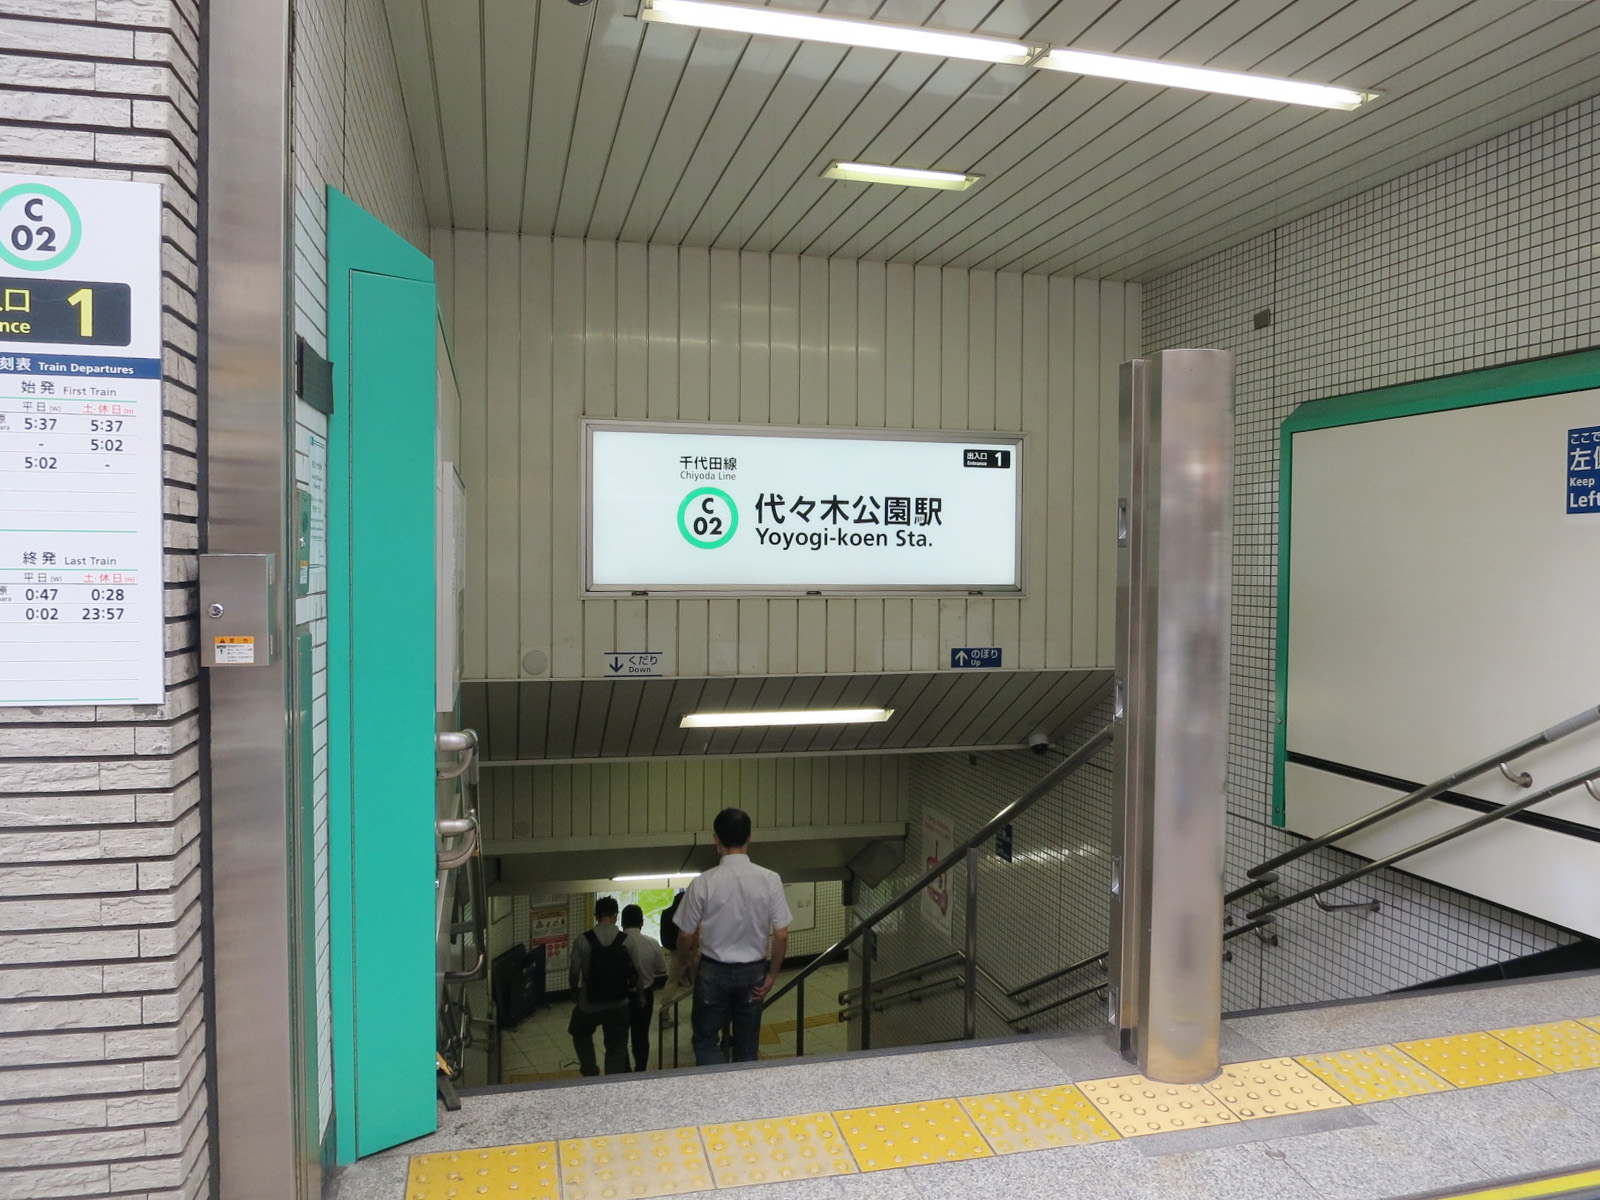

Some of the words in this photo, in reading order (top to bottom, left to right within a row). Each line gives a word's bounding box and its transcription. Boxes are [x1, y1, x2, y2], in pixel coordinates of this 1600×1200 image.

[24, 198, 44, 222] C
[11, 225, 57, 252] 02
[67, 288, 95, 338] 1
[38, 361, 67, 372] Train
[71, 363, 135, 375] Departures
[63, 386, 87, 396] First
[90, 387, 117, 397] Train
[24, 417, 57, 431] 5:37
[90, 419, 123, 433] 5:37
[90, 438, 124, 452] 5:02
[966, 451, 988, 460] 出入口
[994, 451, 1002, 467] 1
[24, 456, 58, 470] 5:02
[679, 455, 738, 471] 千代田線
[680, 471, 715, 482] Chiyoda
[718, 471, 737, 481] Line
[1569, 477, 1595, 488] Keep
[701, 497, 714, 515] C
[1569, 490, 1600, 508] Left
[755, 493, 943, 527] 代々木公園駅
[693, 516, 722, 537] 02
[755, 527, 888, 551] Yoyogi-koen
[895, 529, 933, 548] Sta.
[64, 556, 87, 566] Last
[90, 556, 117, 566] Train
[25, 588, 58, 601] 0:47
[91, 588, 125, 601] 0:28
[25, 607, 59, 620] 0:02
[82, 607, 125, 620] 23:57
[628, 656, 658, 665] くだり
[971, 649, 998, 659] のぼり
[971, 659, 981, 667] Up
